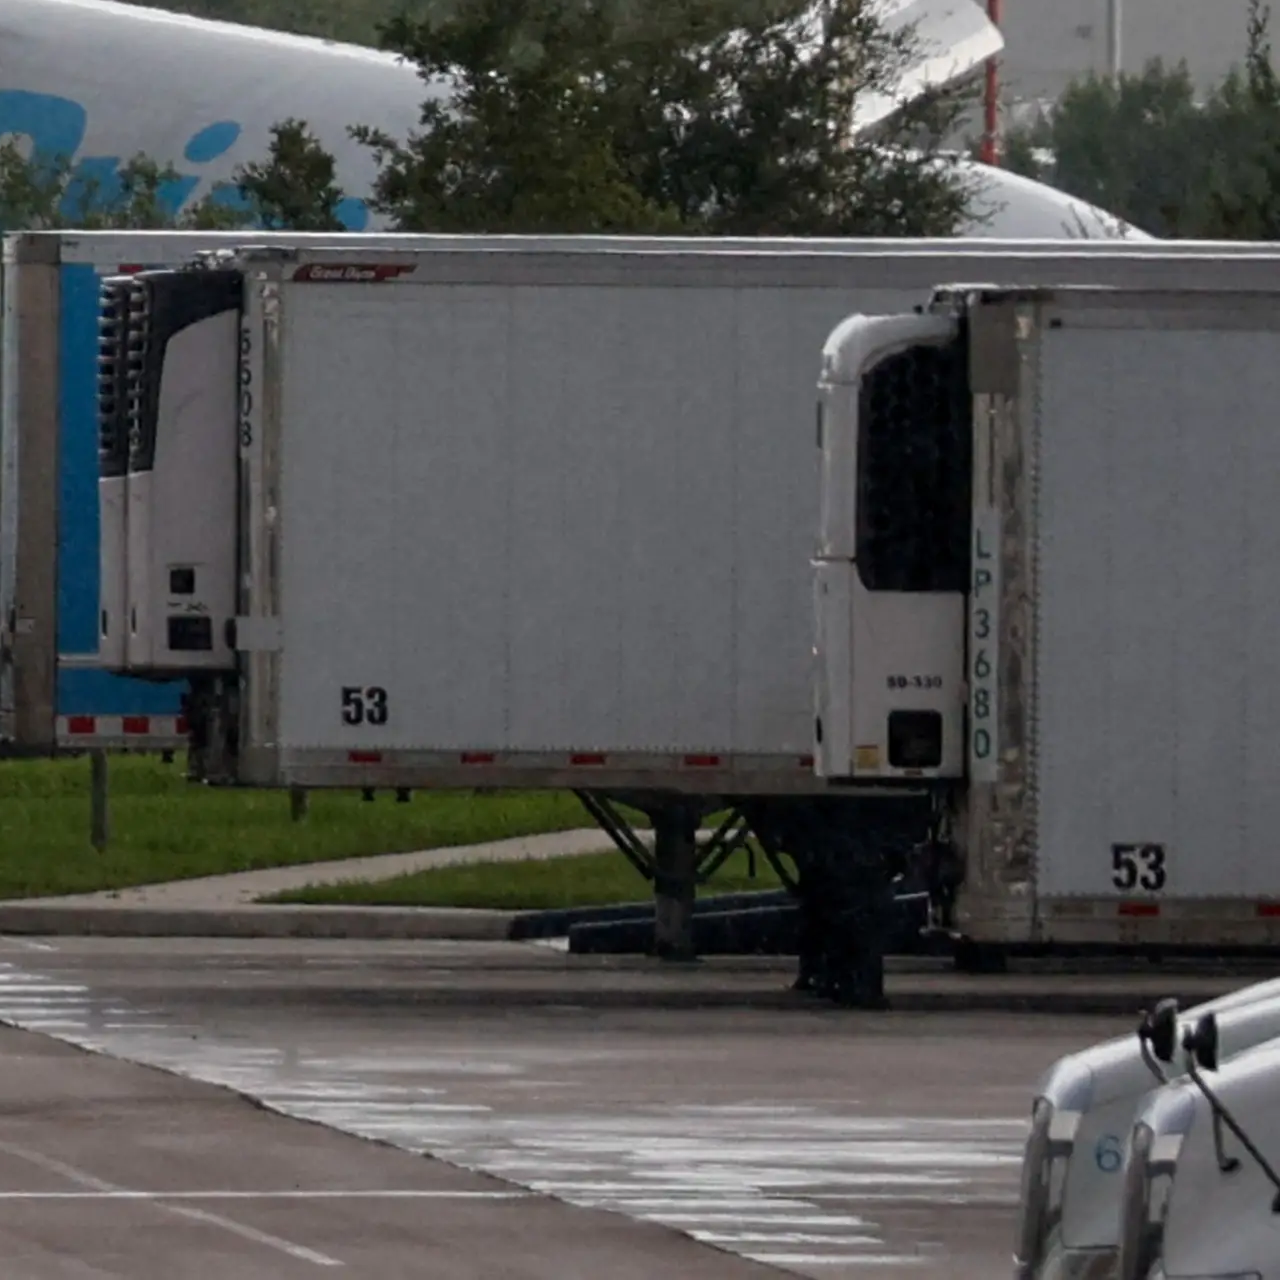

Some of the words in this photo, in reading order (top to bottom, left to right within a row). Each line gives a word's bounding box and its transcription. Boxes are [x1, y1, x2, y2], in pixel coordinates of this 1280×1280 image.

[974, 528, 991, 759] LP3680
[341, 685, 388, 726] 53
[1111, 842, 1166, 891] 53
[1095, 1134, 1122, 1172] 6
